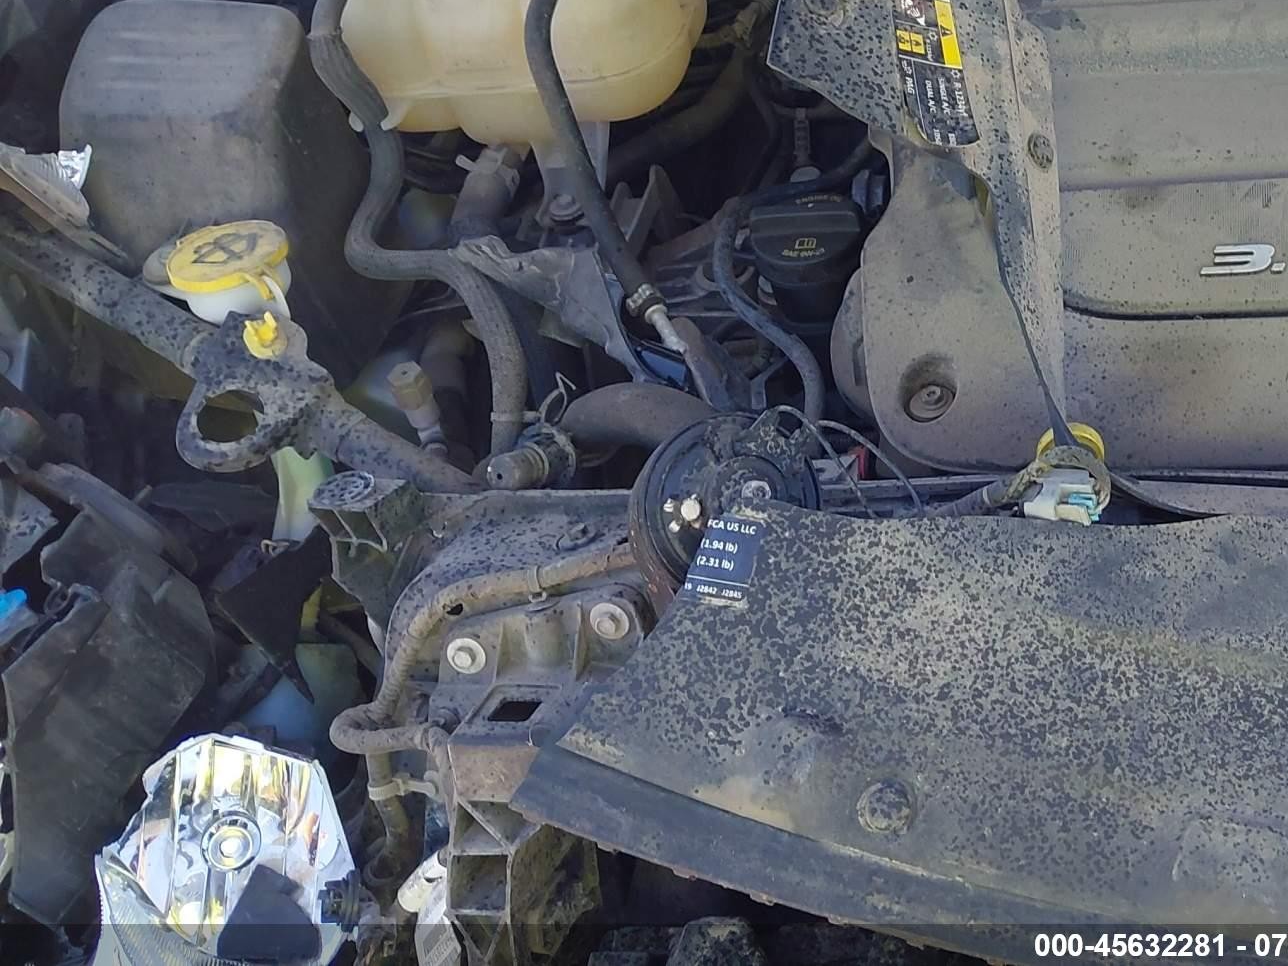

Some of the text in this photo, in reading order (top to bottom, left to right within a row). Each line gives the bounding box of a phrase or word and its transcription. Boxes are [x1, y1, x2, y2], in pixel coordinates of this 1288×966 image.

[906, 77, 915, 95] PAG
[707, 518, 757, 535] FCA US LLC
[700, 537, 738, 554] (1.94 lb)
[696, 554, 735, 572] (2.31 lb)
